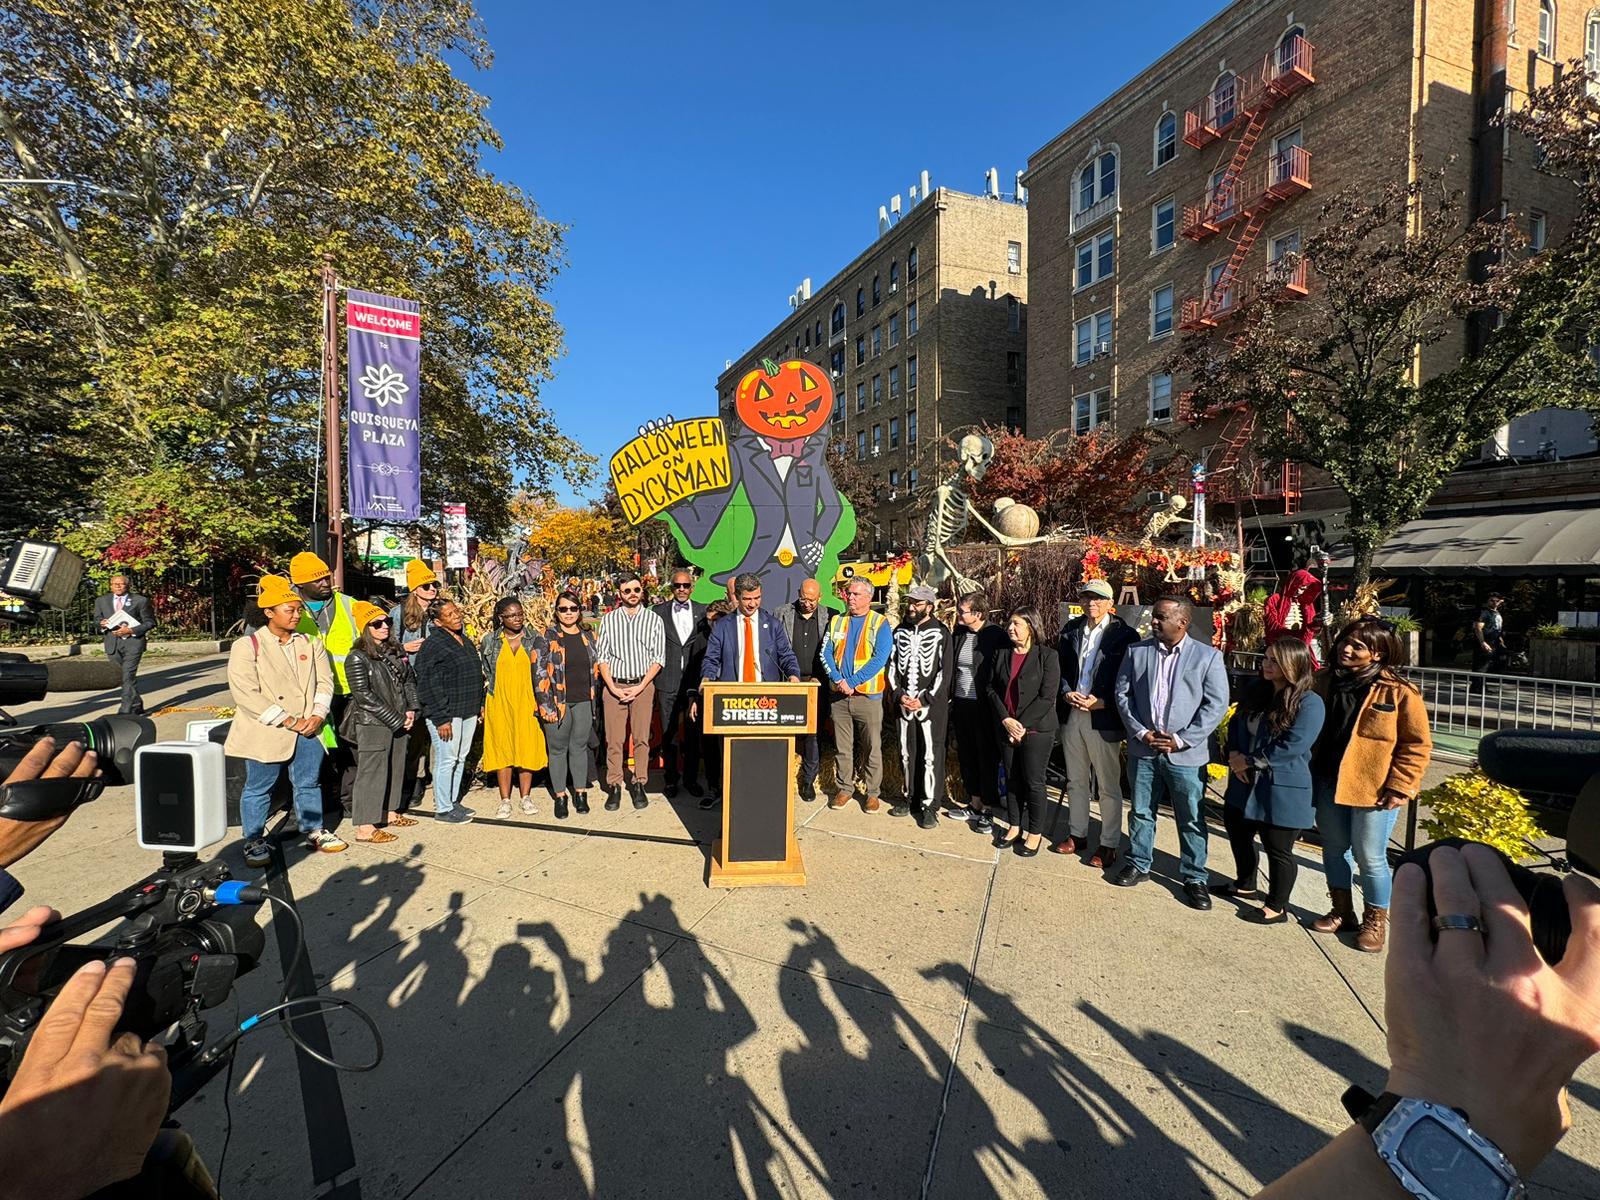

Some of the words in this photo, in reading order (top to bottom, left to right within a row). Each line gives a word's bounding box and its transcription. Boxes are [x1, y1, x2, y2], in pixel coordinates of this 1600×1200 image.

[355, 311, 413, 331] WELCOME
[351, 410, 418, 431] QUISQUEYA
[363, 430, 405, 447] PLAZA
[612, 420, 724, 484] HALLOWEEN
[663, 452, 684, 470] ON
[621, 456, 729, 523] DYCKMAN
[722, 698, 758, 709] TRICK
[722, 709, 778, 721] STREETS
